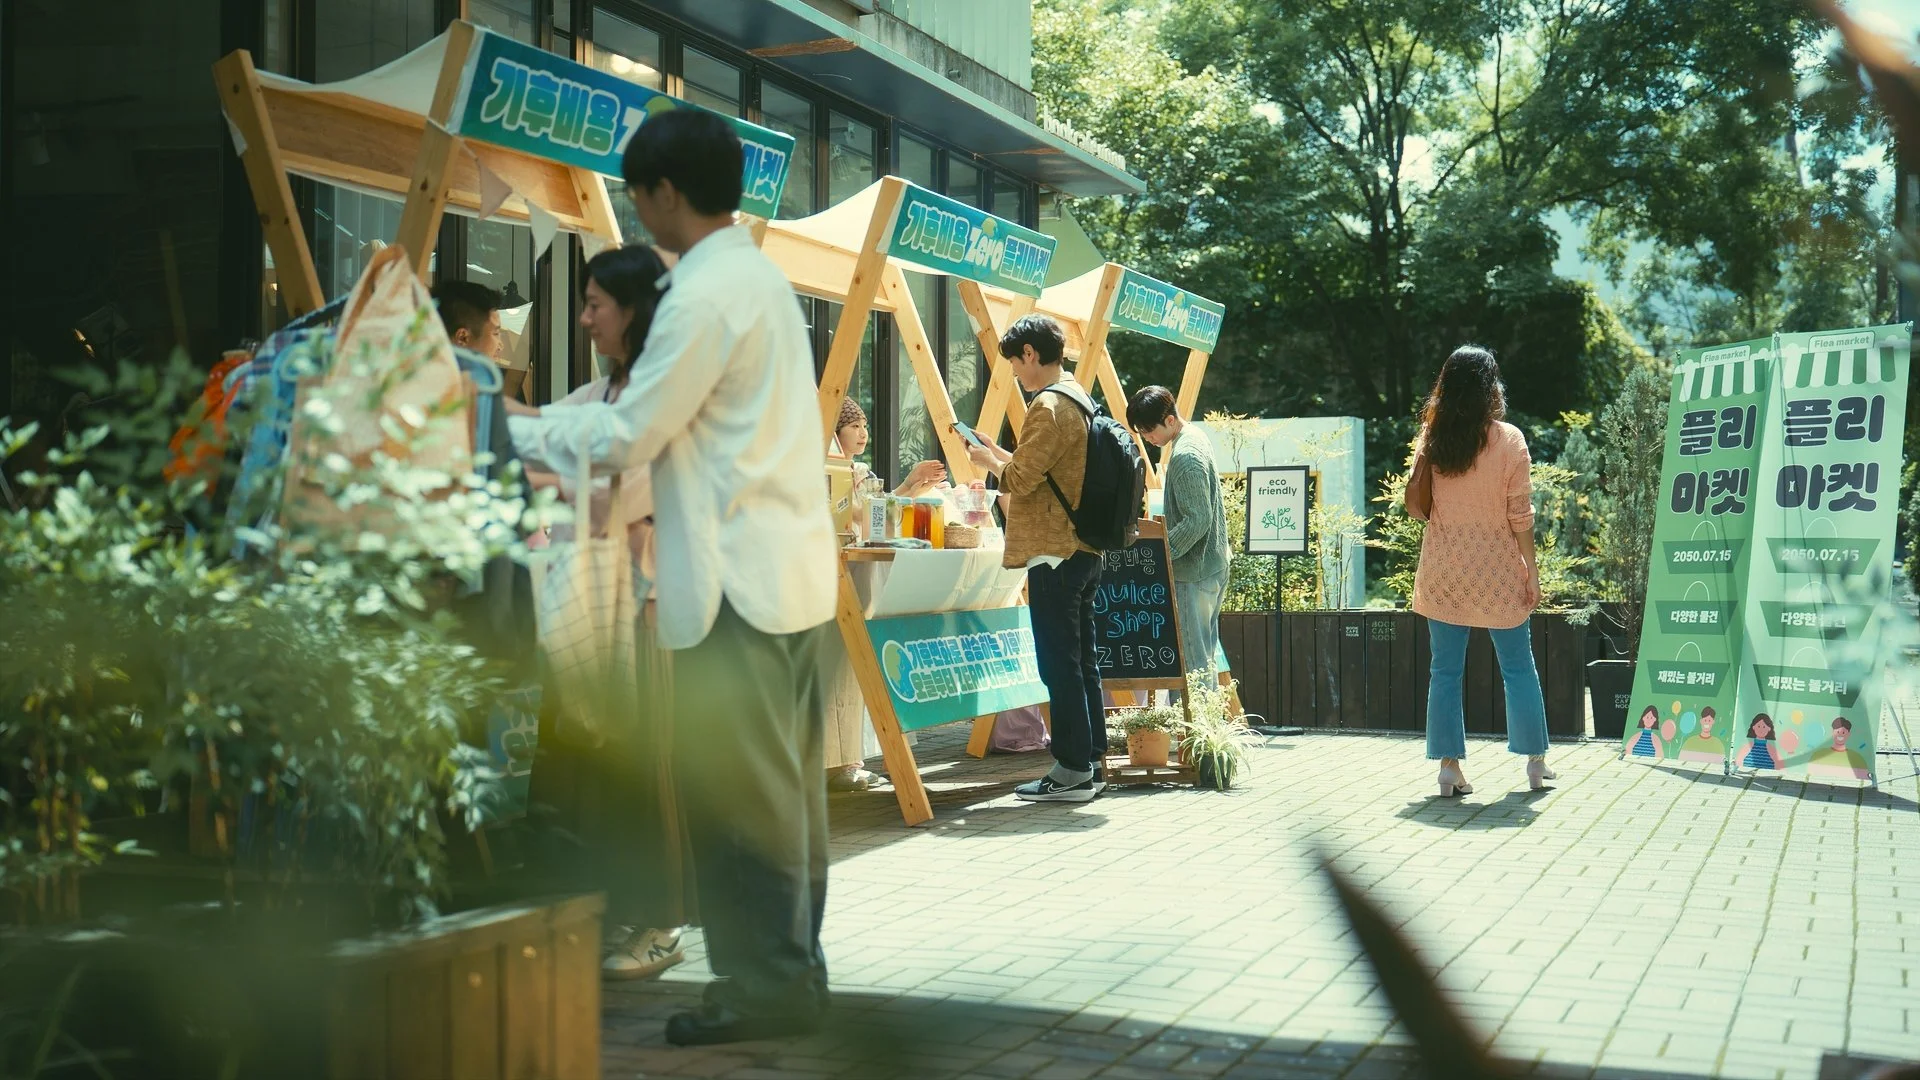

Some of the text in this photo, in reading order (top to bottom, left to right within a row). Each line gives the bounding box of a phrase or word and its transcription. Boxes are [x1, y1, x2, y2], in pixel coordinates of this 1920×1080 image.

[480, 57, 621, 156] 기후비용
[741, 138, 787, 204] 마켓
[899, 200, 1051, 289] 기후비용 Zero 플리마켓
[1119, 281, 1221, 346] 기후비용 Zero 플리마켓
[1814, 336, 1869, 349] Flea market
[1704, 350, 1747, 363] Flea market
[1679, 404, 1757, 457] 플리
[1783, 394, 1886, 447] 플리
[1258, 487, 1297, 496] friendly
[1670, 467, 1751, 516] 마켓
[1775, 462, 1880, 512] 마켓
[1102, 547, 1155, 575] 후비용
[1673, 550, 1731, 562] 2050.07.15
[1781, 548, 1860, 562] 2050.07.15
[1670, 610, 1718, 623] 다양한 물건
[1781, 612, 1817, 627] 다양한
[960, 632, 1002, 662] 상승하는
[1098, 645, 1175, 669] ZERO
[1658, 670, 1715, 685] 재밌는 볼거리
[1767, 676, 1848, 695] 재밌는 볼거리
